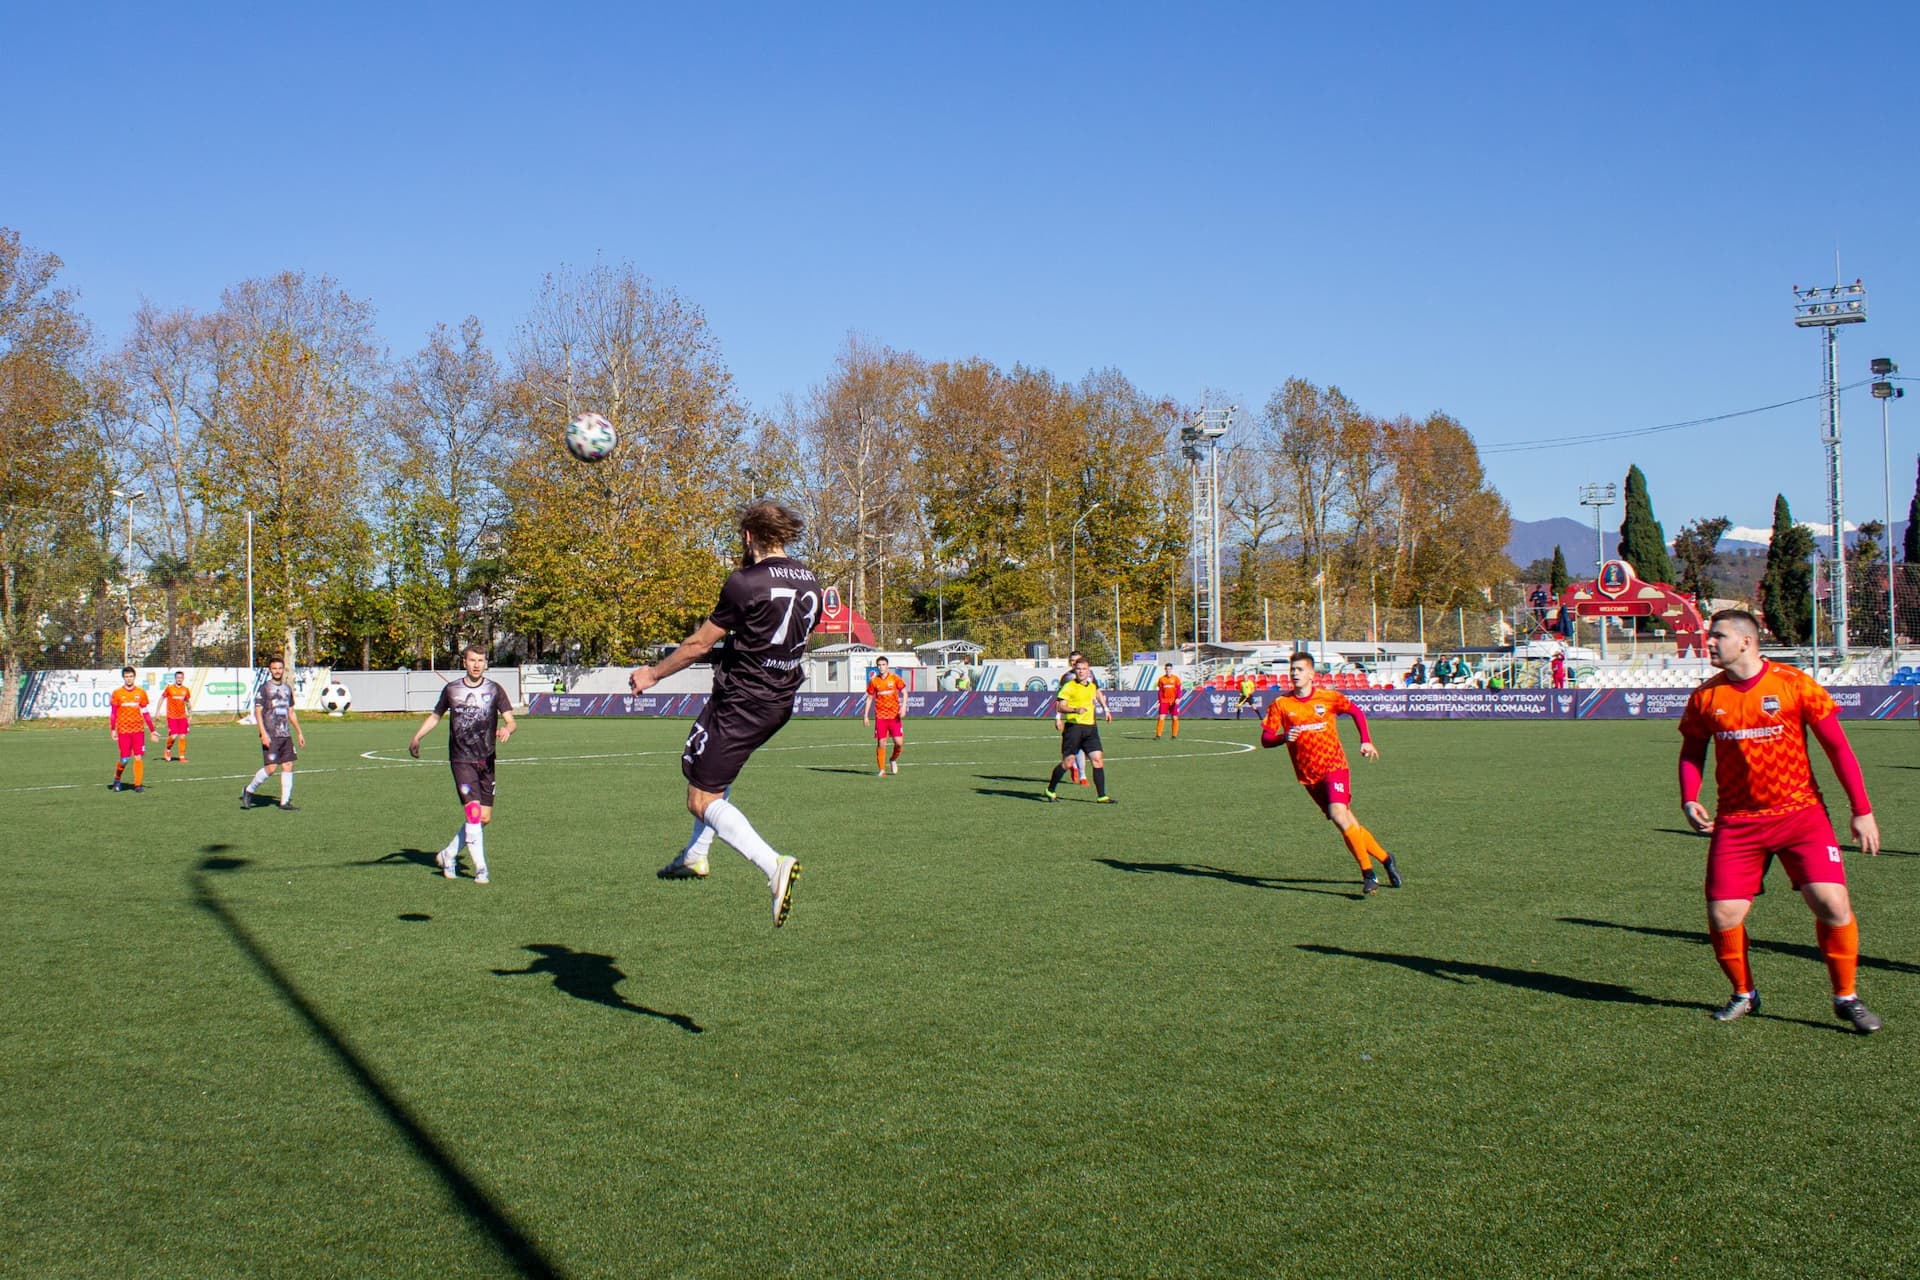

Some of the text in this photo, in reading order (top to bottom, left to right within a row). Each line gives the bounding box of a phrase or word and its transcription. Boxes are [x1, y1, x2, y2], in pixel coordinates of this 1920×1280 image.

[771, 588, 818, 652] 73
[52, 691, 112, 708] 2020 СО
[1409, 694, 1482, 702] СОРЕВНОВАНИЯ
[1501, 694, 1546, 702] ФУТБОЛУ
[1373, 704, 1406, 713] СРЕДИ
[1408, 704, 1492, 712] ЛЮБИТЕЛЬСКИХ
[1494, 704, 1546, 713] КОМАНД»
[686, 722, 708, 755] 73
[1826, 845, 1841, 863] 13
